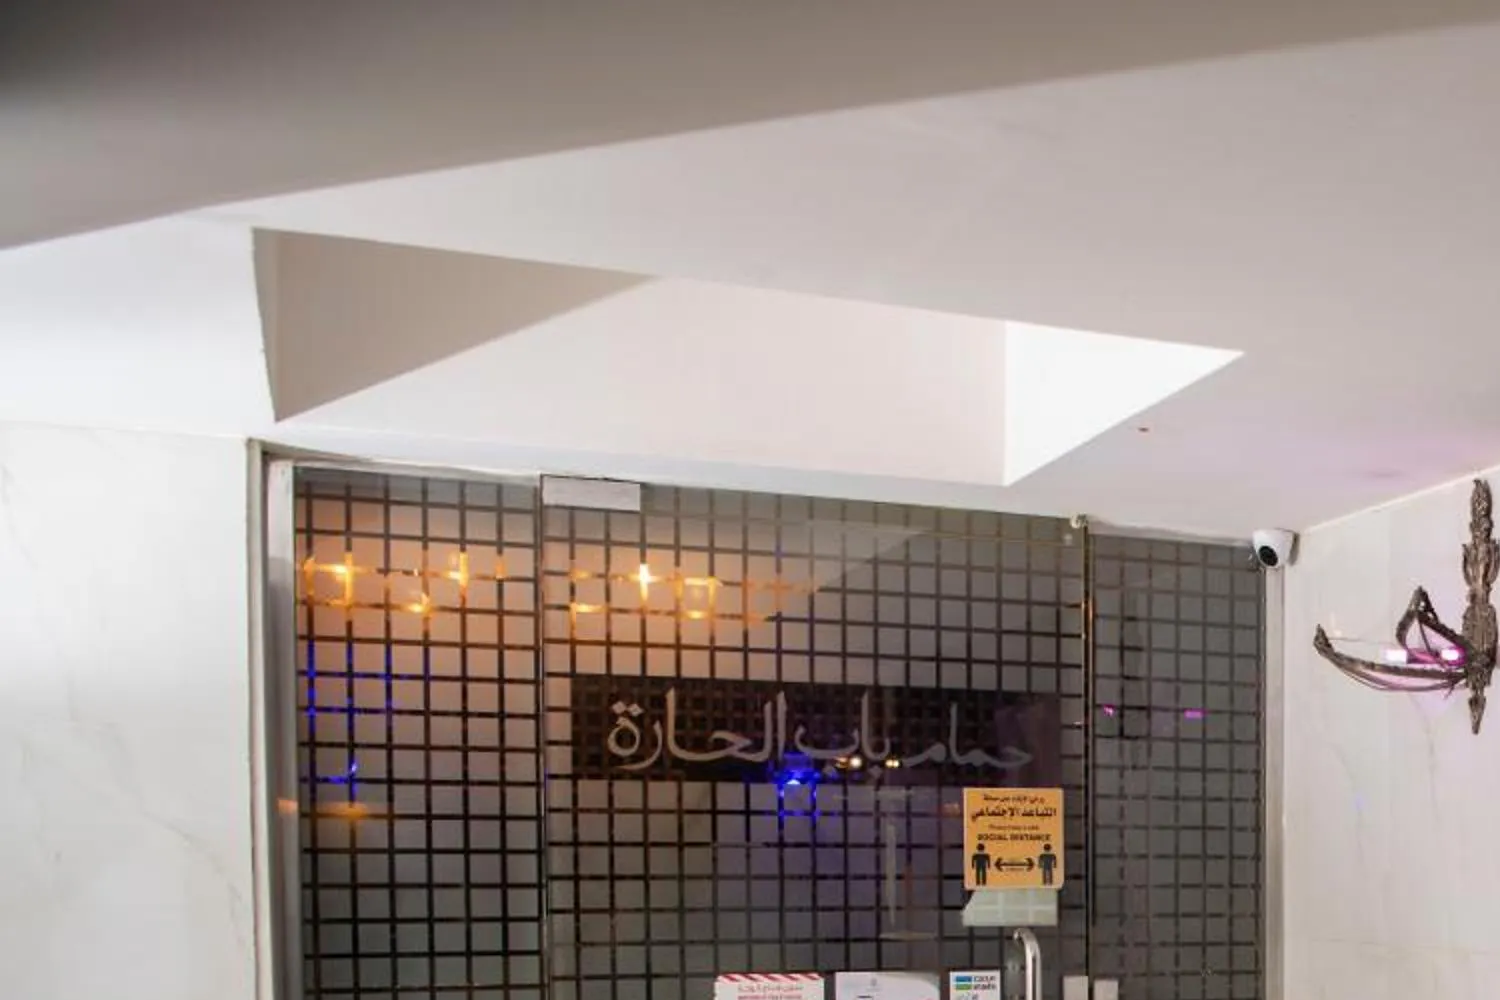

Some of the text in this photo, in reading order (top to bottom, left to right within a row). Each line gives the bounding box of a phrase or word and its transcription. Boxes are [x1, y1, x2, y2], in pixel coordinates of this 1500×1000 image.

[606, 688, 1032, 778] حمام باب الحارة
[977, 833, 1052, 841] SOCIAL DISTANCE
